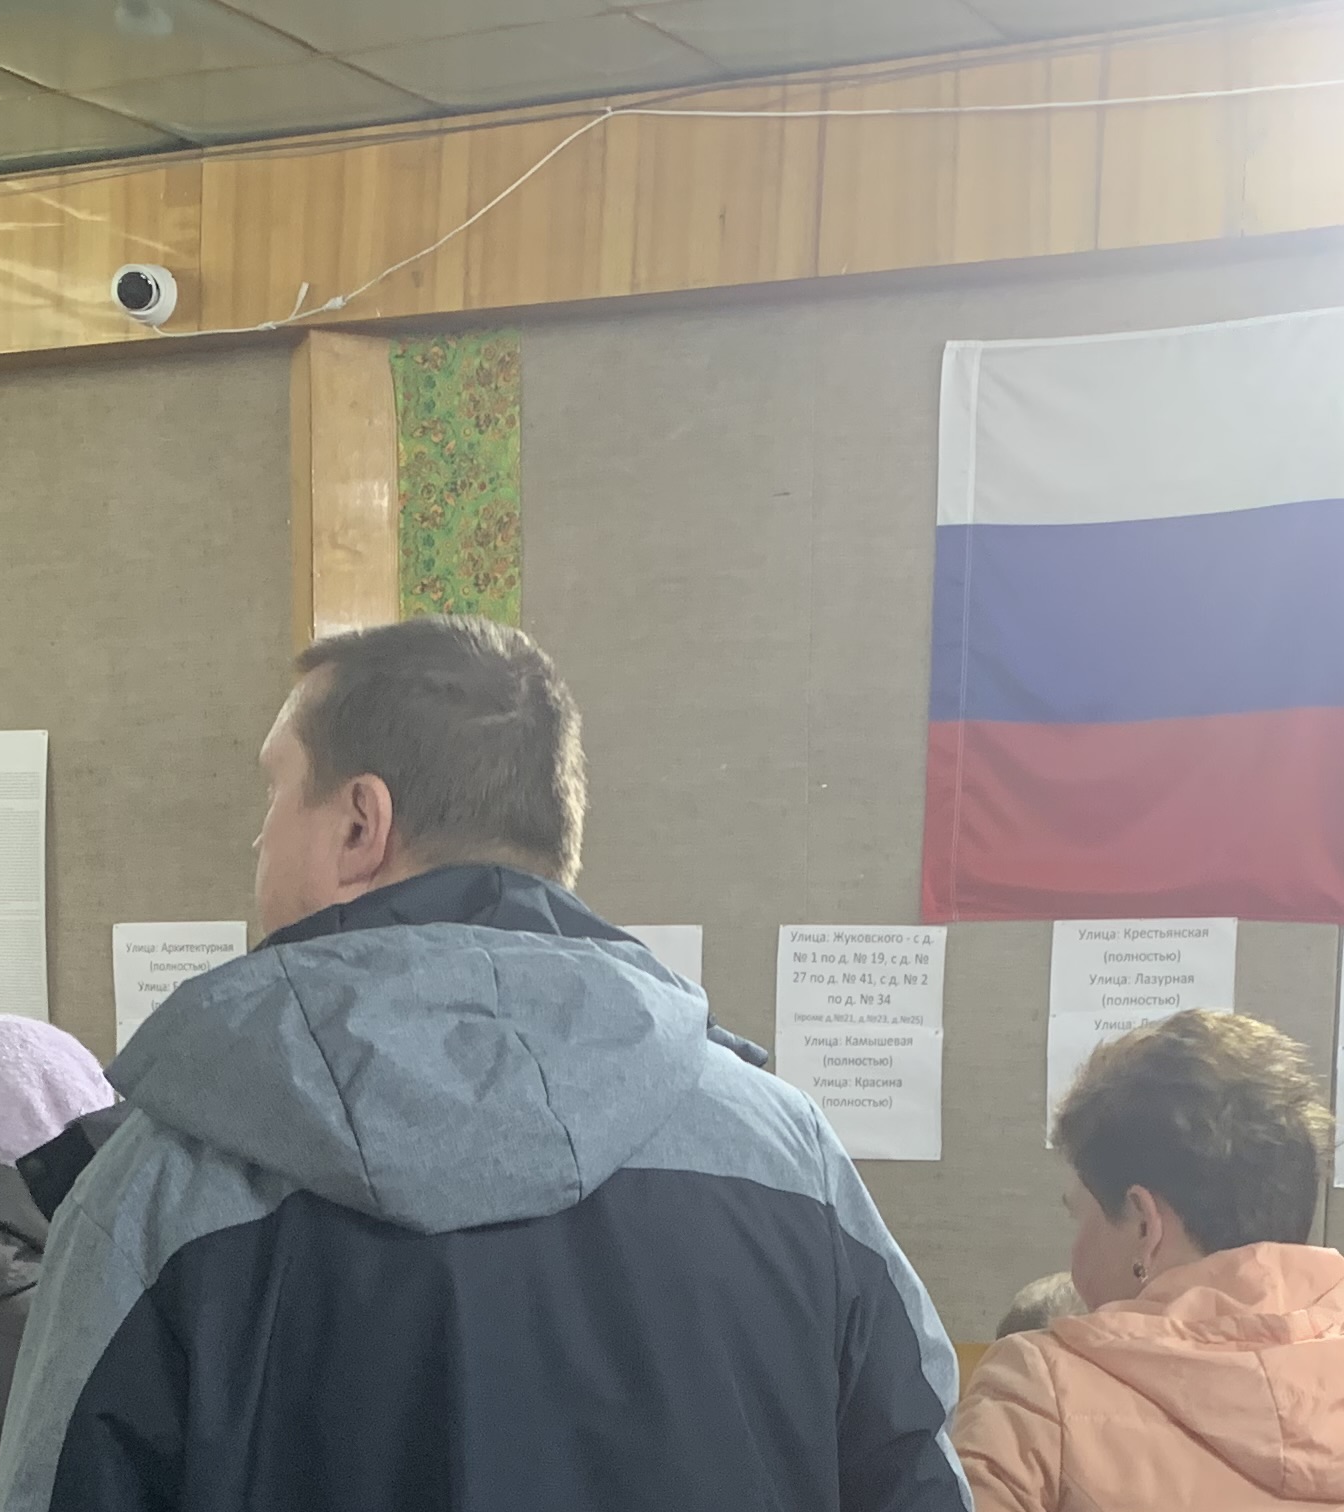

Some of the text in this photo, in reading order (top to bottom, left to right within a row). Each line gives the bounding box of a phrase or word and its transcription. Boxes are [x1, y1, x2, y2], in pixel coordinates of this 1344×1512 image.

[790, 932, 829, 943] Улица:
[833, 932, 903, 945] Жуковского
[913, 935, 919, 943] с
[922, 934, 934, 945] д.
[1078, 928, 1209, 941] Улица: Крестьянская
[126, 942, 234, 954] Улица: Архитектурная
[794, 952, 929, 965] № 1 по д. № 19, с д. №
[1104, 950, 1181, 964] (полностью)
[150, 960, 210, 972] (полностью)
[793, 972, 928, 986] 27 по д. № 41, с д. № 2
[1089, 973, 1194, 986] Улица: Лазурная
[138, 982, 170, 992] Улица:
[828, 994, 891, 1006] по д. № 34
[1102, 994, 1180, 1008] (полностью)
[804, 1036, 913, 1047] Улица: Камышевая
[823, 1055, 893, 1068] (полностью)
[813, 1077, 902, 1090] Улица: Красина
[822, 1096, 893, 1108] (полностью)
